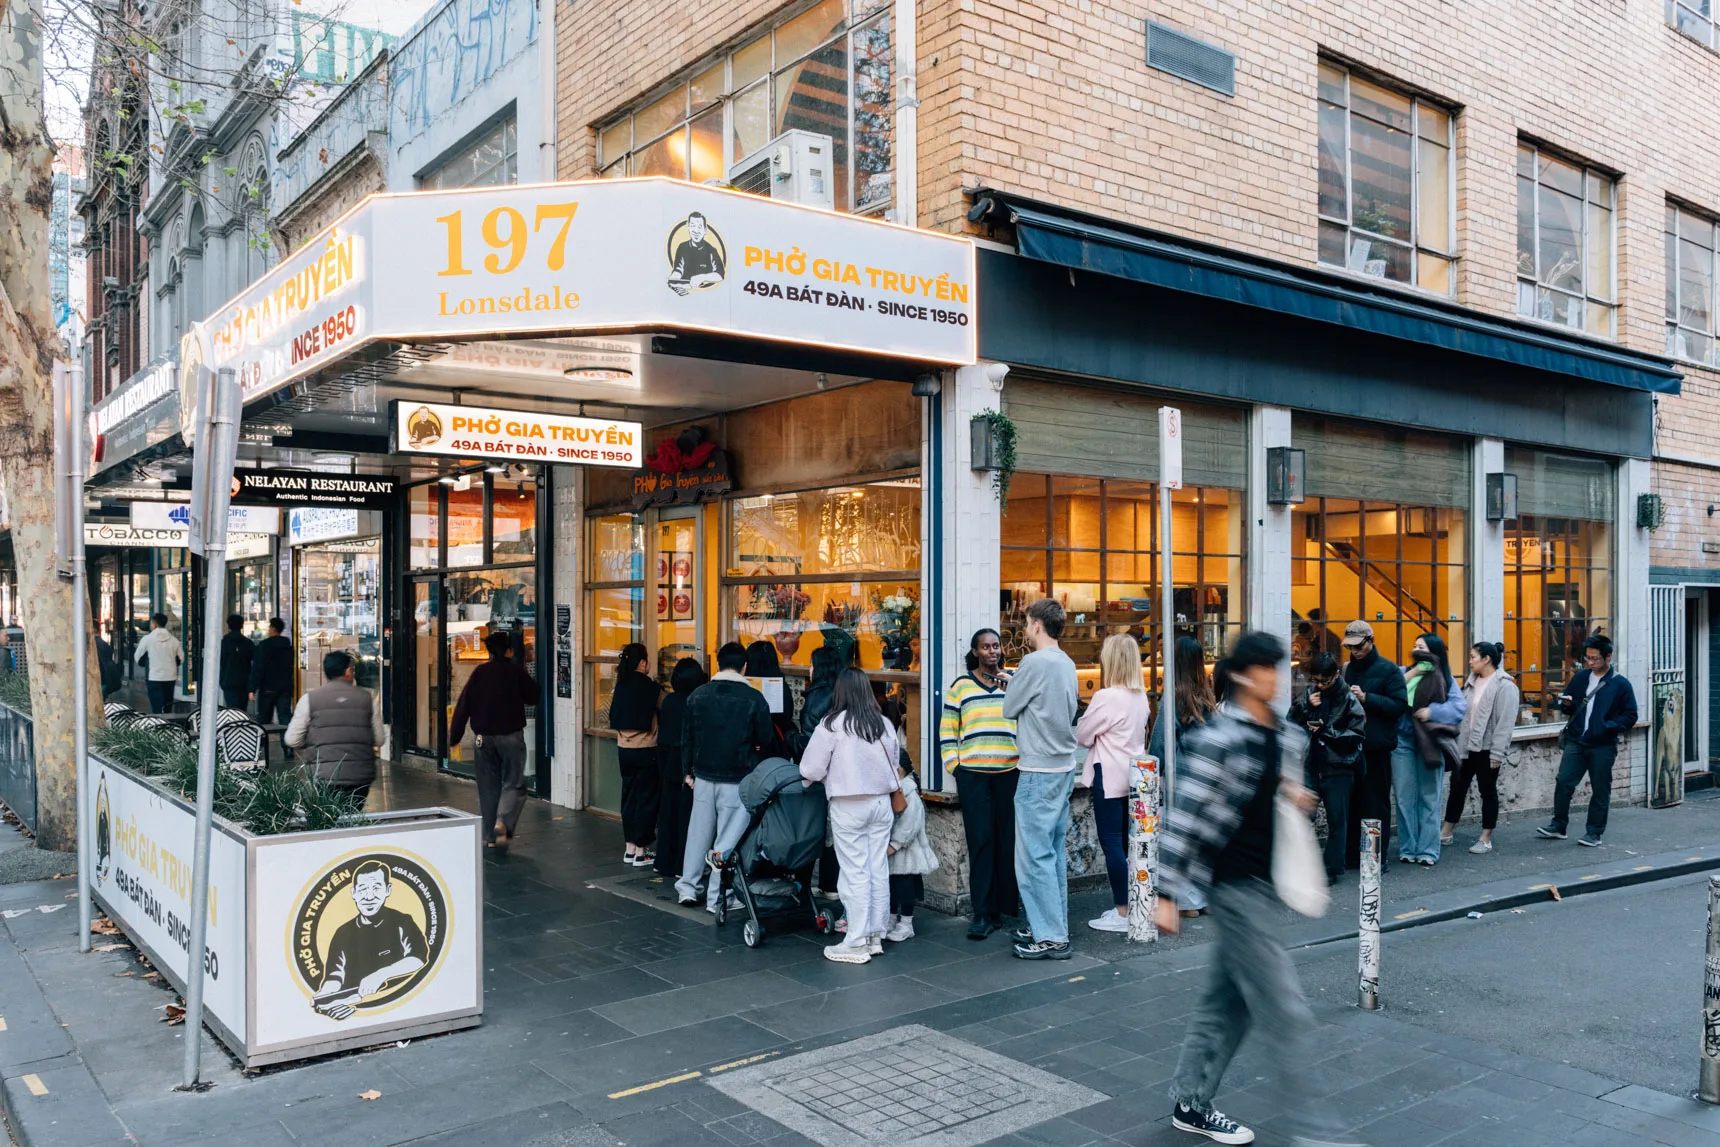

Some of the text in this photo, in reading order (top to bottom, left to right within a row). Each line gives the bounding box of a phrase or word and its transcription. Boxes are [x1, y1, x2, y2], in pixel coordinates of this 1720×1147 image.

[435, 201, 579, 277] 197
[744, 246, 968, 304] PHỞ GIA TRUYỀN
[437, 285, 581, 316] Lonsdale
[743, 280, 969, 326] 49A BÁT ĐÀN SINCE 1950
[291, 305, 356, 366] INCE 1950
[451, 414, 633, 446] PHỞ GIA TRUYỀN
[451, 439, 633, 462] 49A BÁT ĐÀN SINCE 1950
[244, 475, 393, 493] NELAYAN RESTAURANT
[276, 492, 365, 503] Authentic Indonesian Food
[85, 525, 182, 540] TOBACCO
[115, 813, 137, 861] PHỞ
[138, 832, 159, 880] GIA
[392, 866, 408, 877] 49A
[407, 871, 422, 886] BÁT
[115, 866, 130, 897] 49A
[129, 877, 144, 910] BÁT
[144, 889, 162, 927] ĐÀN
[204, 946, 219, 981] 50
[428, 901, 437, 925] SINCE
[300, 921, 313, 947] GIA
[428, 926, 437, 946] 1950
